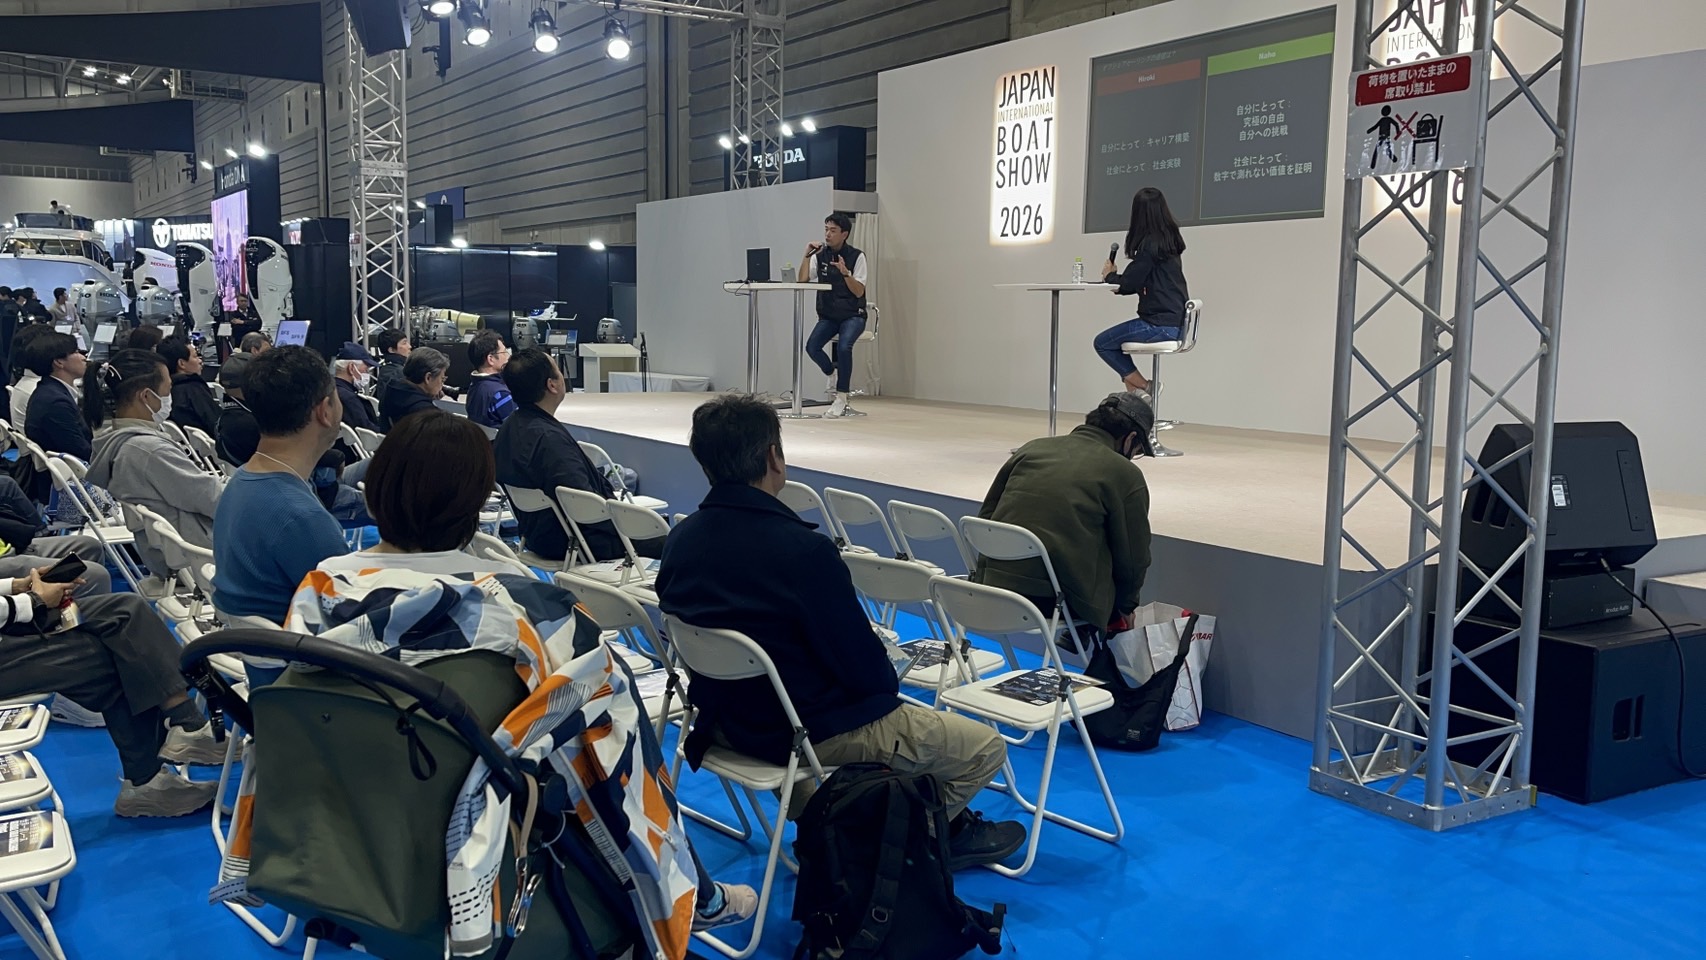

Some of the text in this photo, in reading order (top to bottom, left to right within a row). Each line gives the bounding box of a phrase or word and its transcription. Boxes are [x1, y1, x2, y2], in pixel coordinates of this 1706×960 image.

[1258, 51, 1277, 60] Naho
[1138, 73, 1156, 83] Hiroki
[1368, 62, 1457, 88] 荷物を置いたままの
[999, 66, 1055, 108] JAPAN
[1384, 80, 1436, 99] 席取り禁止
[997, 102, 1053, 123] INTERNATIONAL
[1243, 112, 1285, 128] 究極の自由
[997, 117, 1053, 155] BOAT
[1240, 125, 1289, 141] 自分への挑戦
[996, 152, 1051, 188] SHOW
[1213, 162, 1312, 182] 数字で測れない価値を証明
[1000, 203, 1043, 237] 2026
